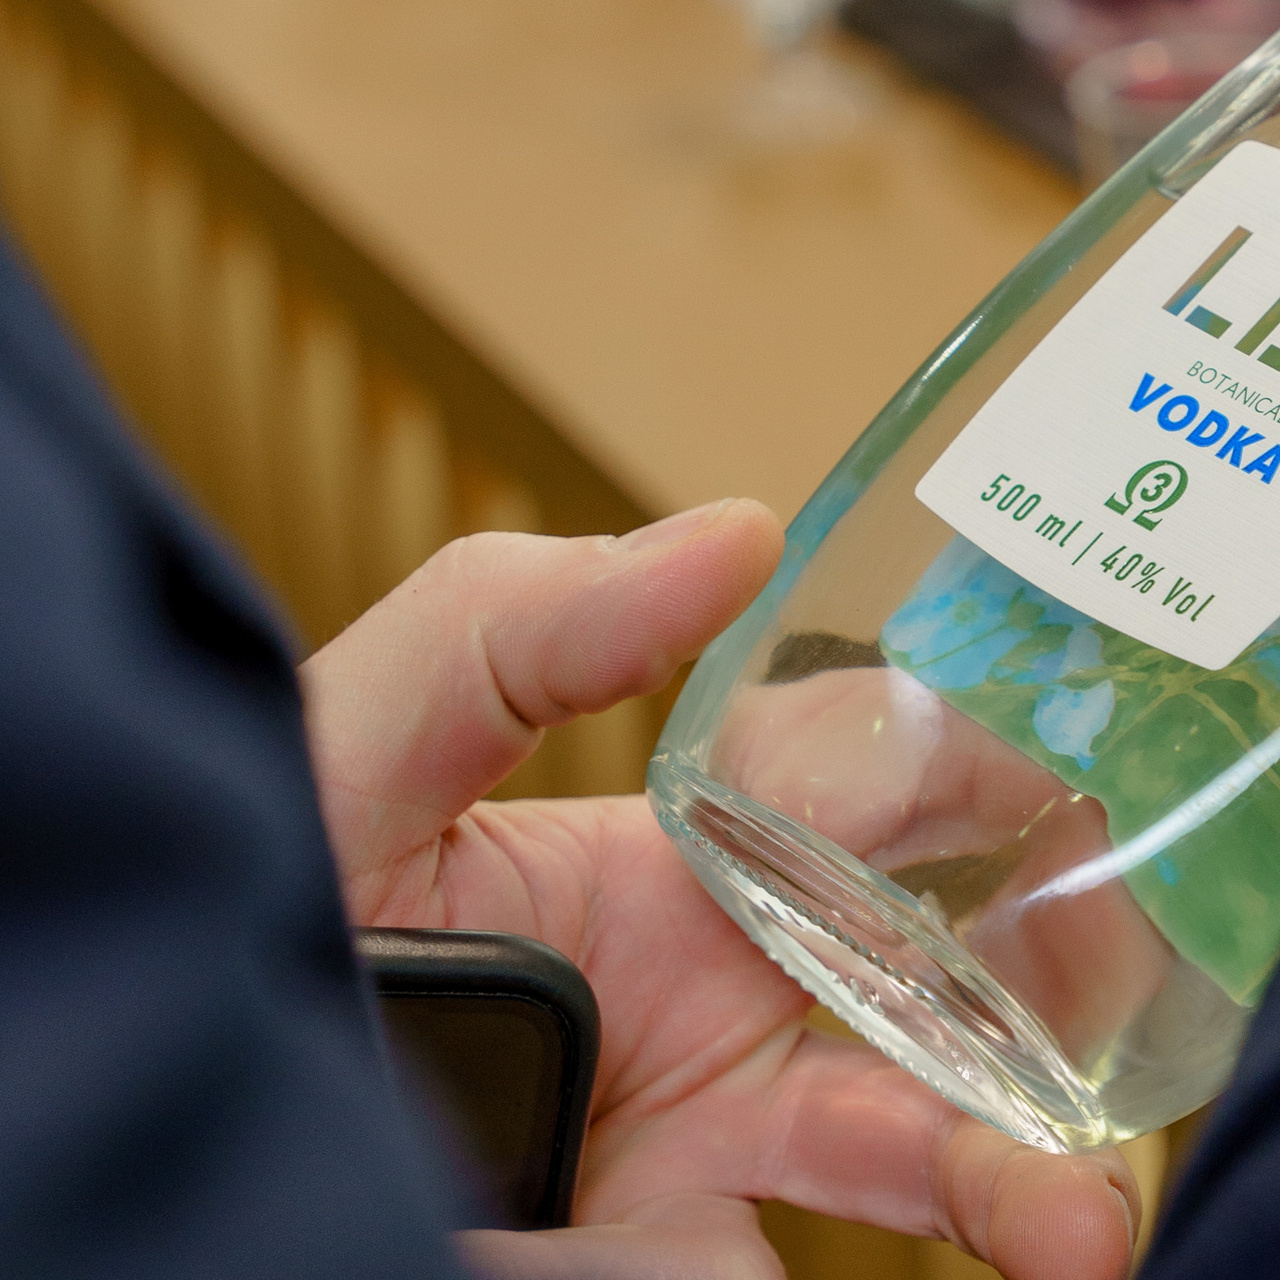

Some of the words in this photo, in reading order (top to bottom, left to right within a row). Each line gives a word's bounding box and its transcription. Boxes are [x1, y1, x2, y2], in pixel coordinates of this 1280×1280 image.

[981, 474, 1042, 521] 500
[1035, 514, 1083, 548] ml
[1100, 545, 1165, 594] 40%
[1162, 577, 1216, 622] Vol
